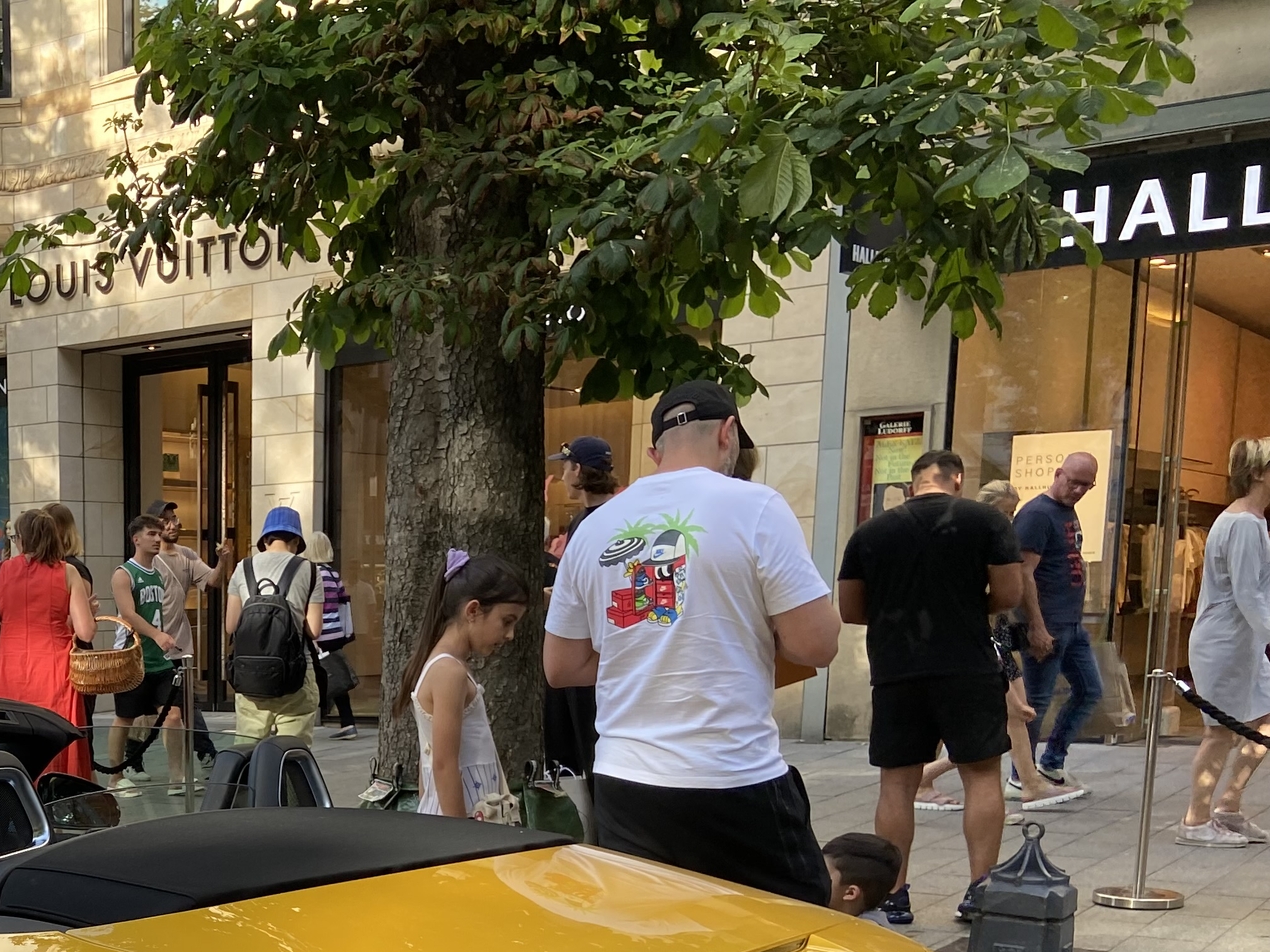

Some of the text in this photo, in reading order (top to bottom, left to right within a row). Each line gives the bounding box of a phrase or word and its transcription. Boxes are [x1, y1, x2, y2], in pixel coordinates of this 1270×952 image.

[1060, 164, 1270, 247] HALL
[1016, 453, 1064, 465] PERSO
[140, 585, 164, 606] BOSTO
